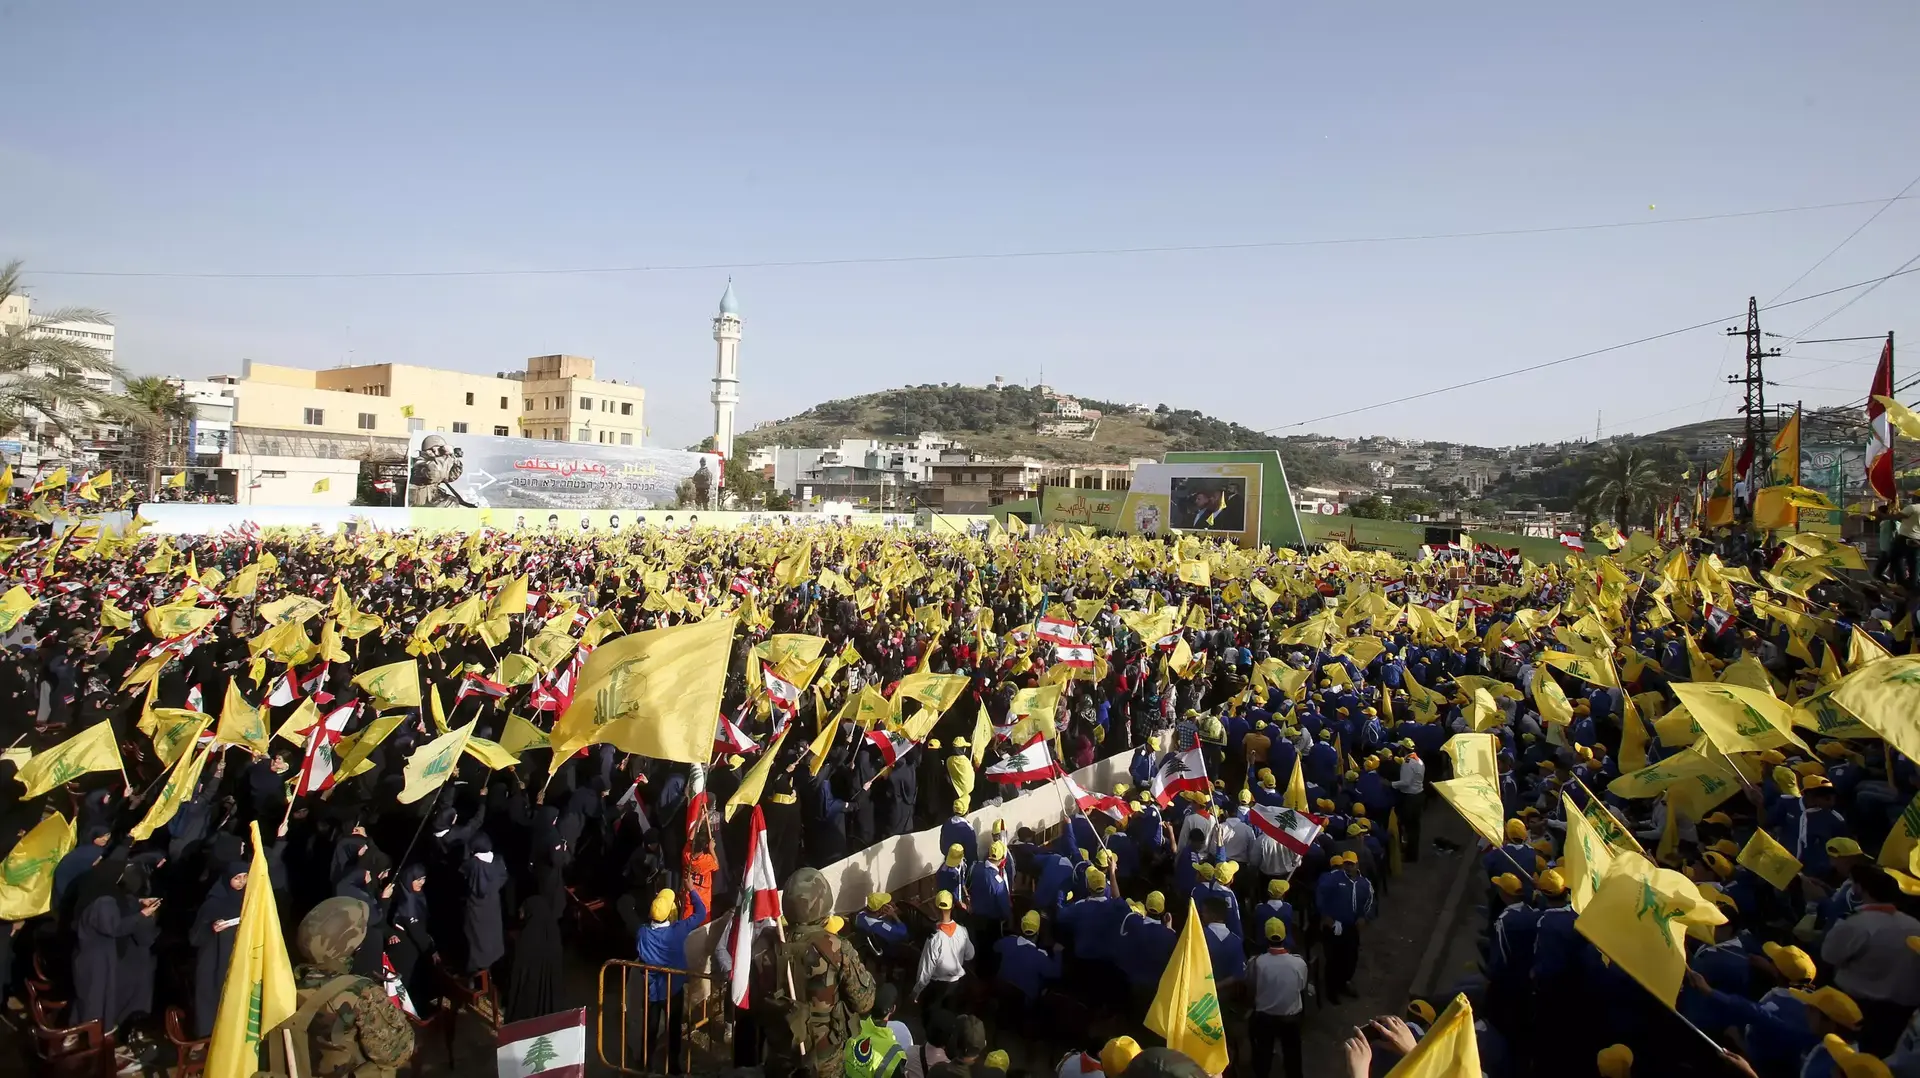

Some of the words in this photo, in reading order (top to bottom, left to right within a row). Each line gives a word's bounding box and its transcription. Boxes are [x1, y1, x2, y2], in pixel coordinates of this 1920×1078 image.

[562, 460, 578, 476] لن
[582, 463, 606, 477] وعد
[542, 478, 556, 488] לא
